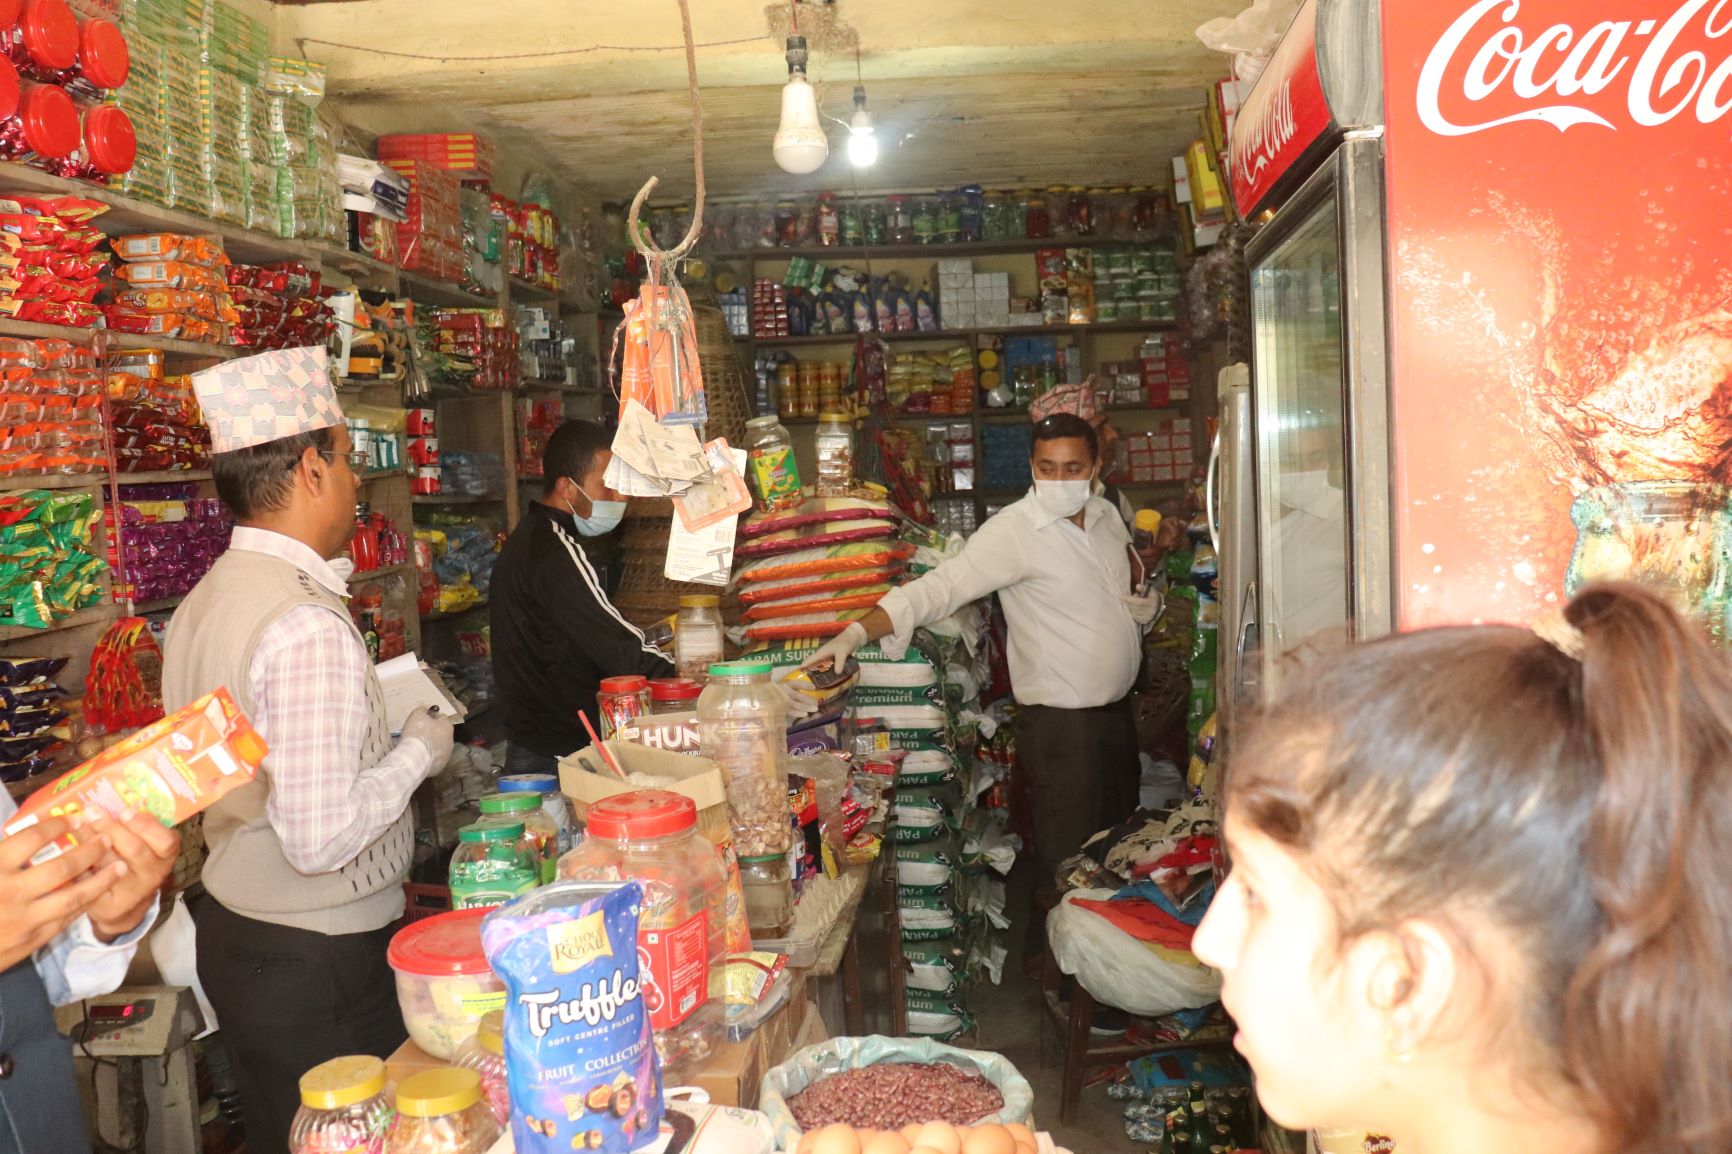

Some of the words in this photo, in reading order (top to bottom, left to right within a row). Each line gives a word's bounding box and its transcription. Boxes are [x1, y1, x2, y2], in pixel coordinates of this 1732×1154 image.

[1416, 0, 1732, 136] Coca-Co
[852, 649, 890, 661] remi
[892, 731, 919, 739] PAR
[901, 775, 928, 785] PAR
[896, 829, 920, 840] PAR
[898, 886, 924, 897] PAR
[574, 1026, 609, 1040] CENTRE
[537, 1063, 577, 1083] FRUIT
[584, 1038, 649, 1074] COLLECTION
